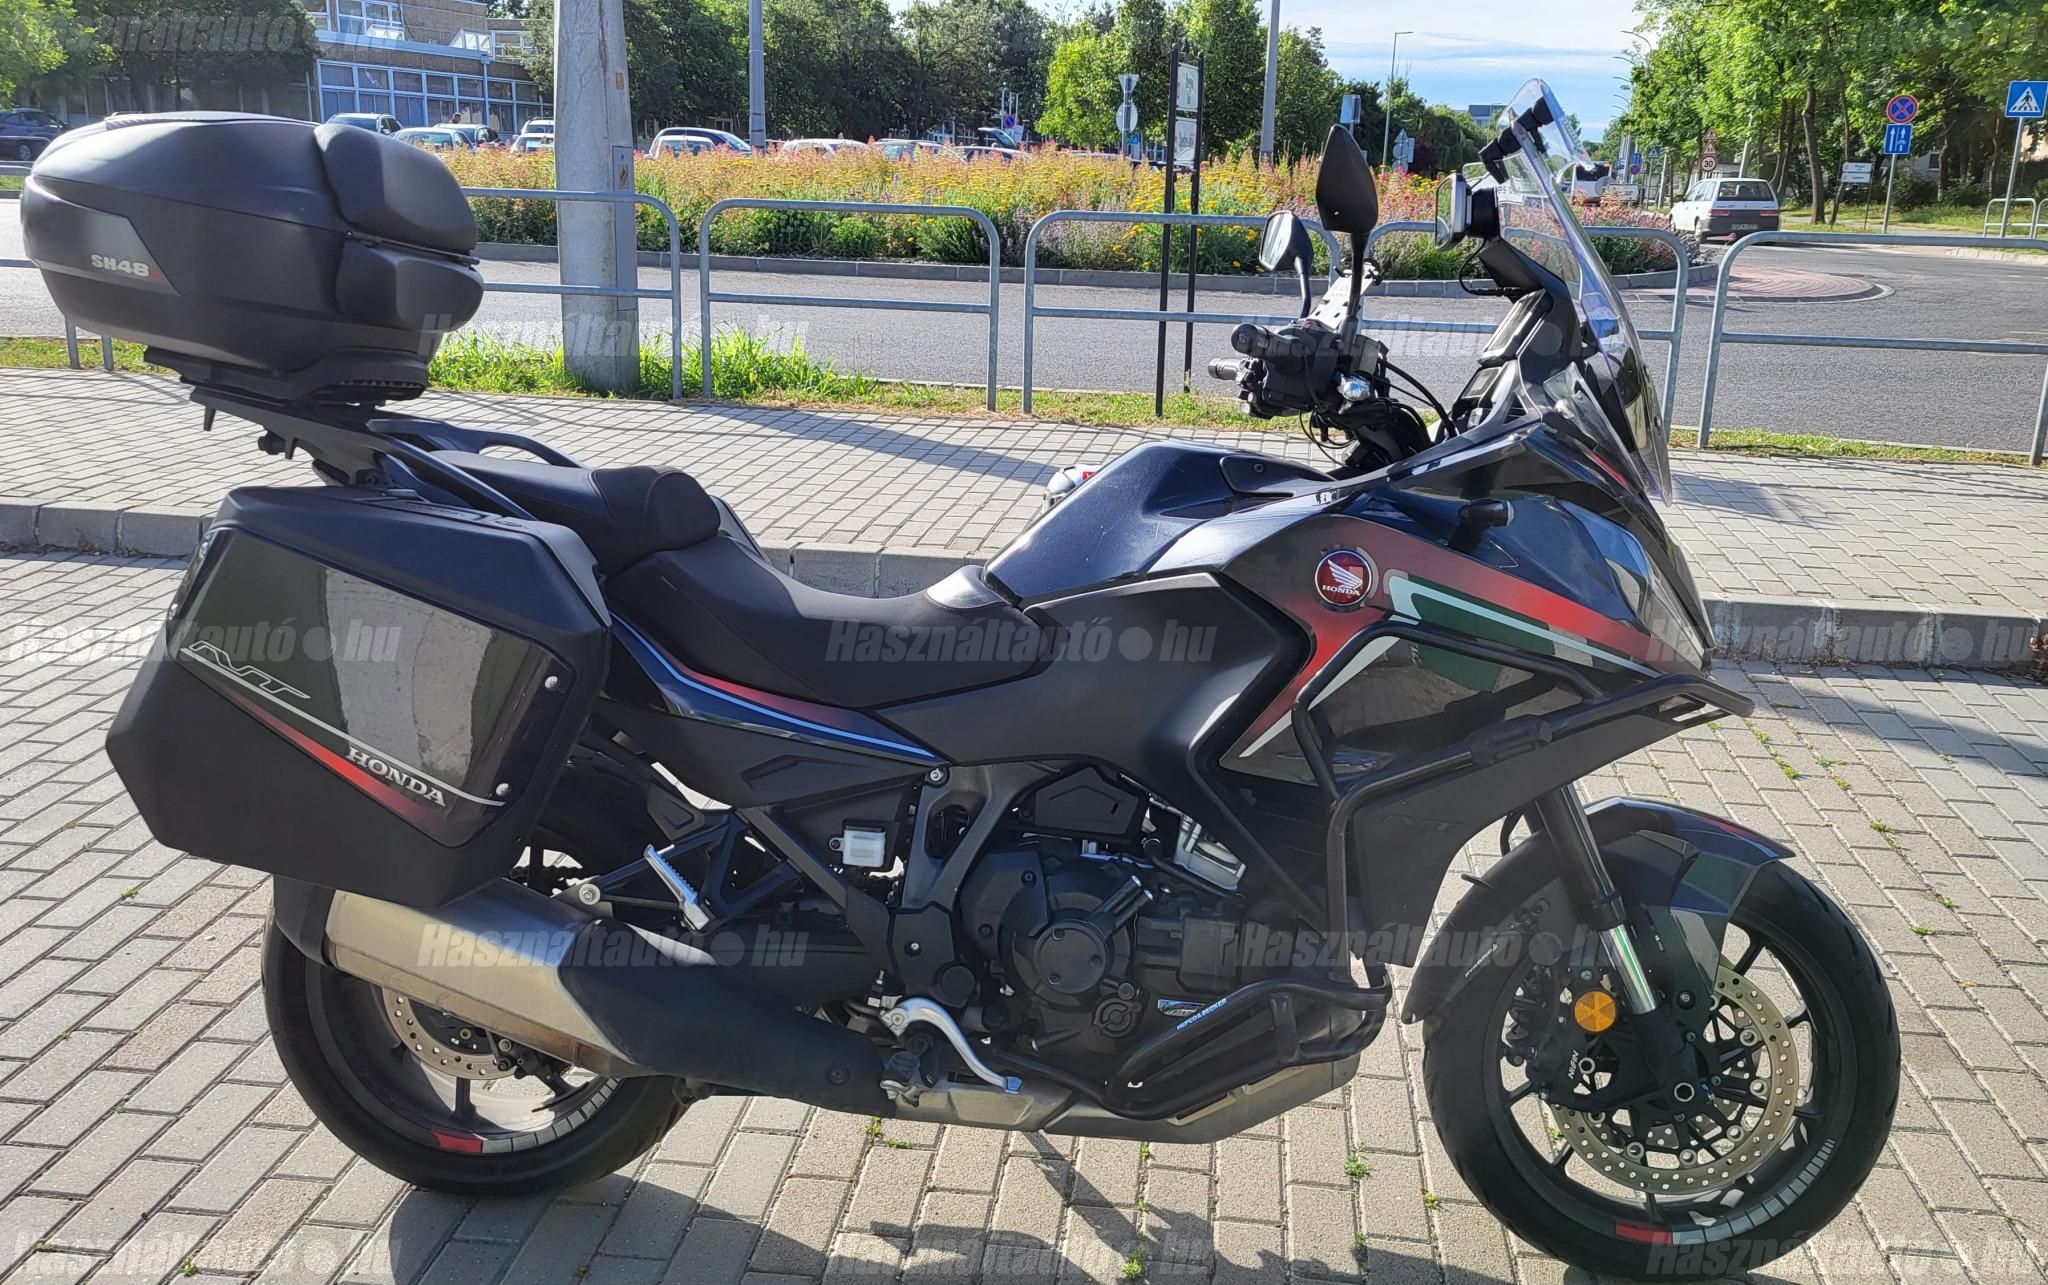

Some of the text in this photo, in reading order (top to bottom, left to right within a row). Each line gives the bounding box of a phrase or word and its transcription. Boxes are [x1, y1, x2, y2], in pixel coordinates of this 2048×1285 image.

[1704, 160, 1714, 168] 30
[91, 254, 150, 277] SH48
[1322, 585, 1361, 596] HONDA
[346, 747, 446, 807] HONDA
